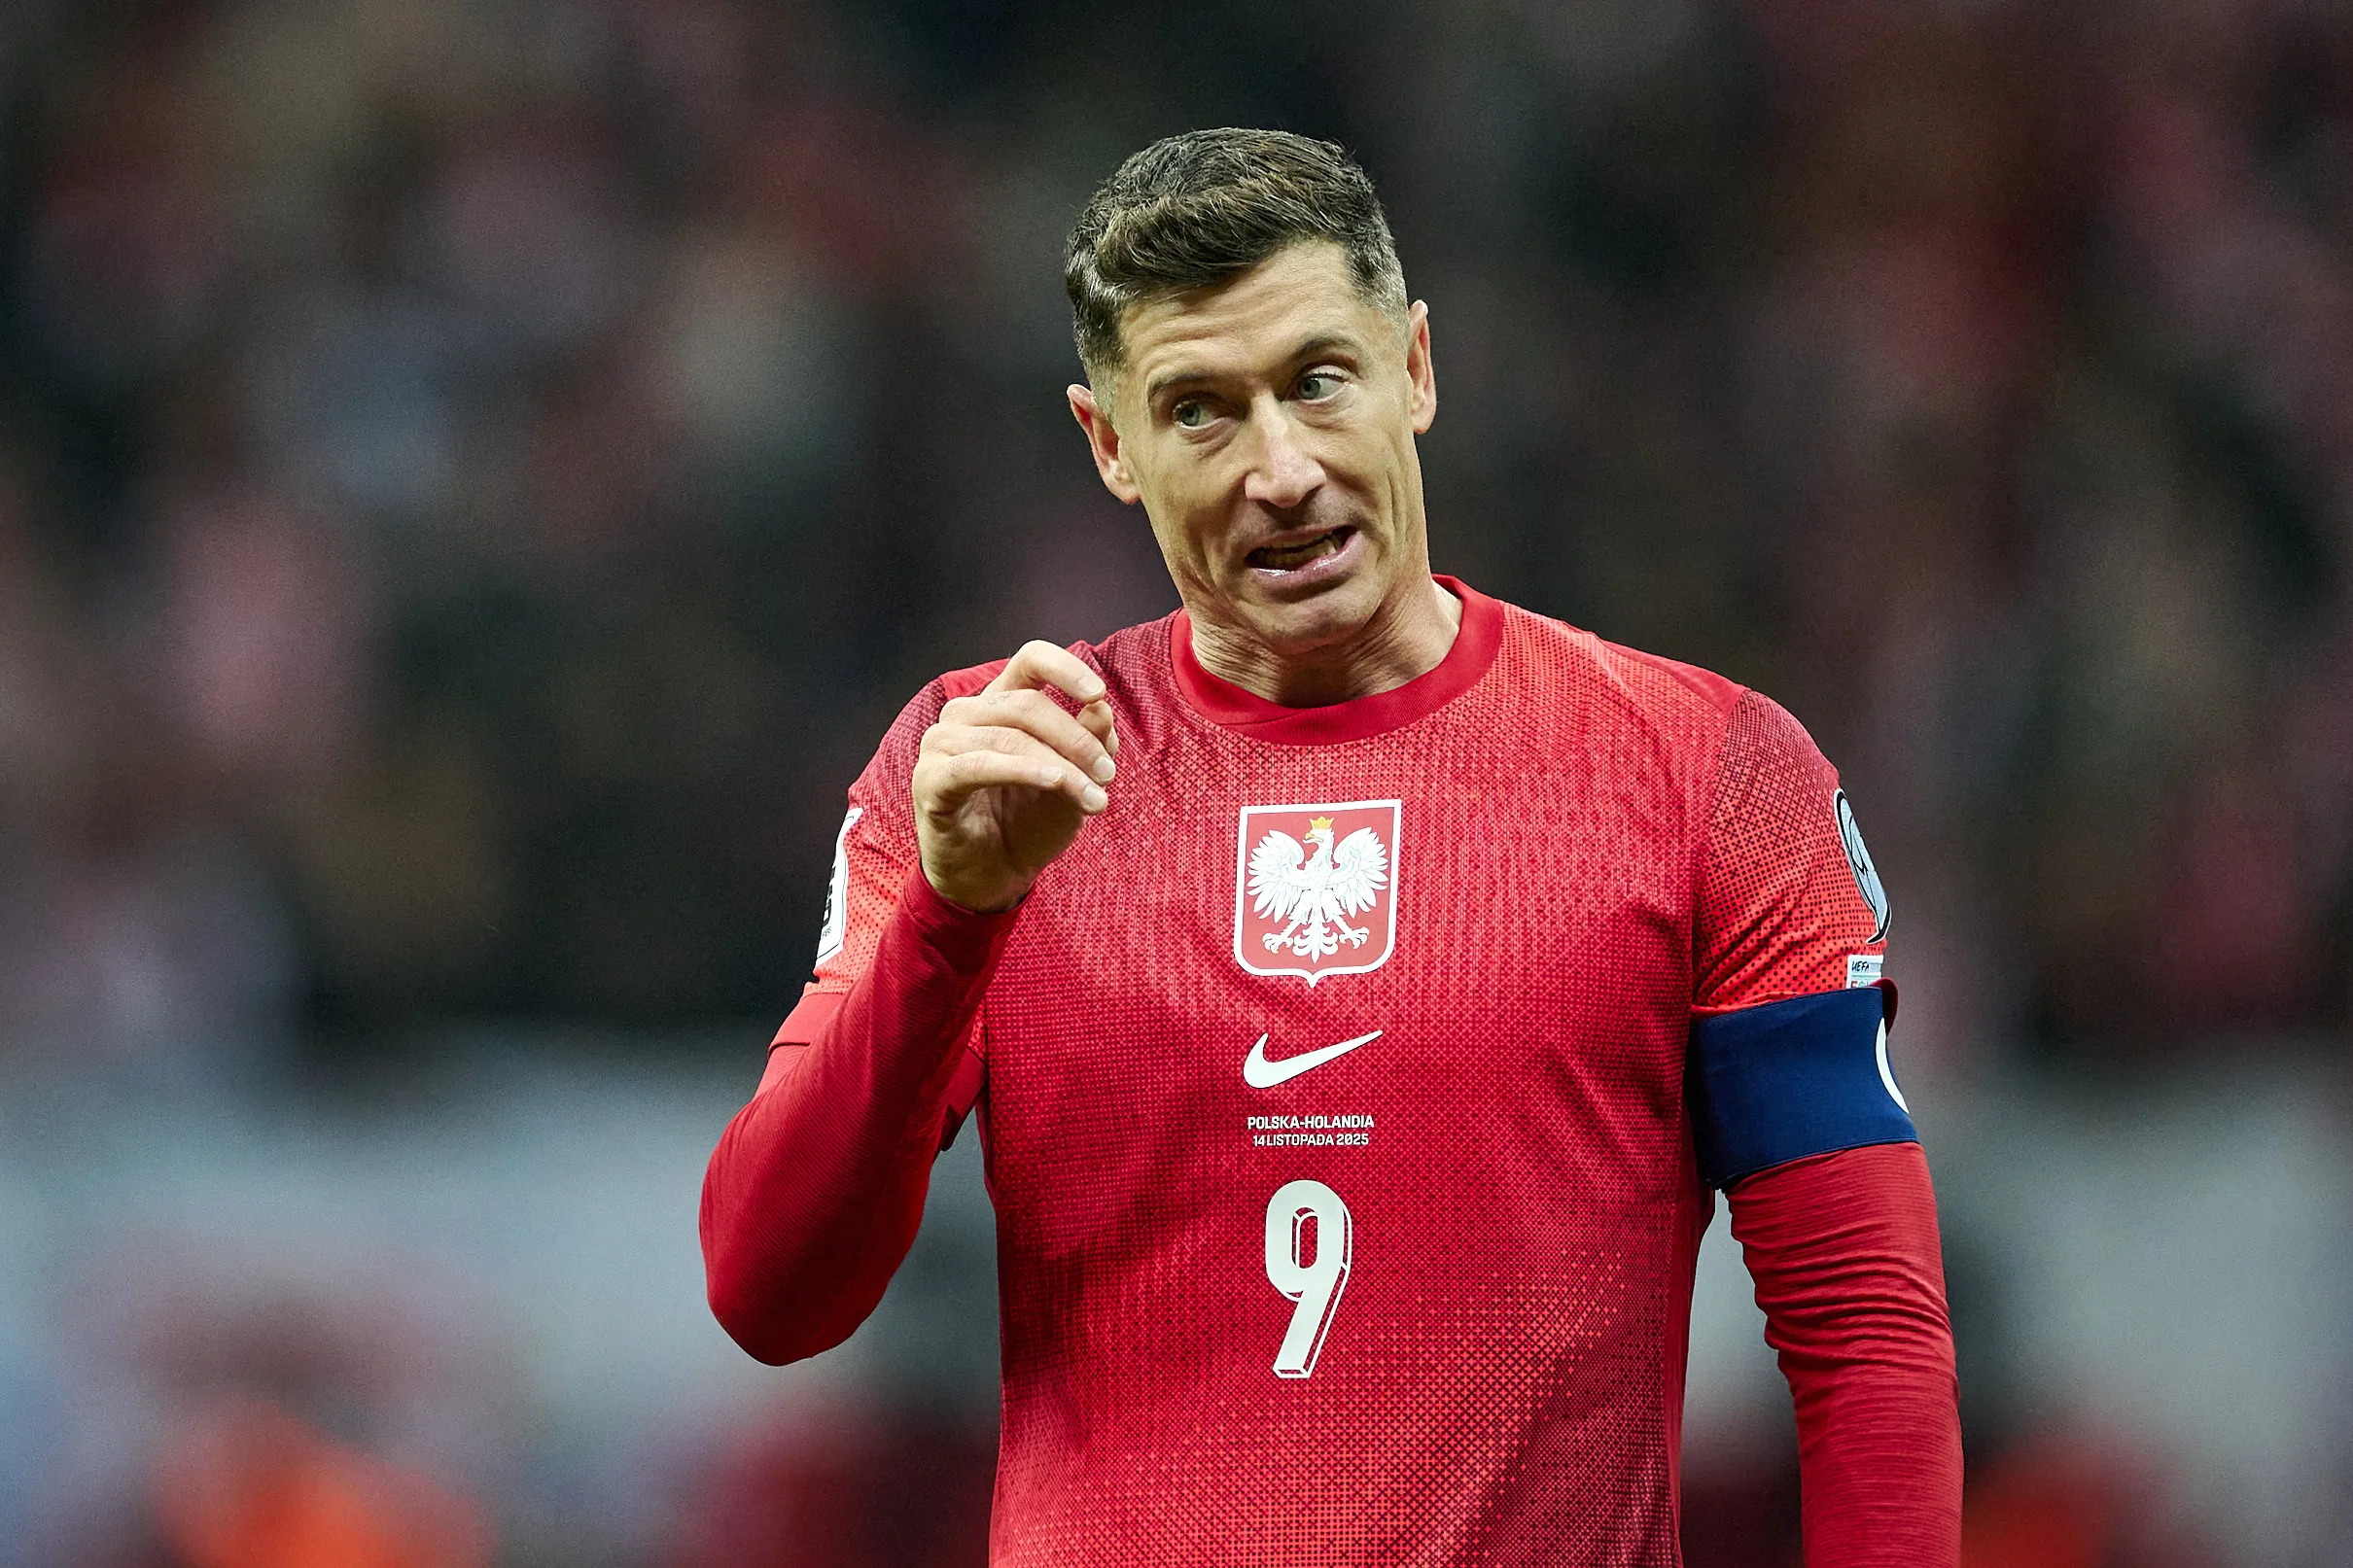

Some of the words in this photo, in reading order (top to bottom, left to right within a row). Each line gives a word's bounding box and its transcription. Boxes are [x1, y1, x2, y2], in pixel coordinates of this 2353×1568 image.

[1247, 1115, 1375, 1130] POLSKA-HOLANDIA
[1253, 1134, 1265, 1146] 14
[1266, 1134, 1335, 1146] LISTOPADA
[1336, 1133, 1369, 1145] 2025
[1265, 1179, 1352, 1378] 9
